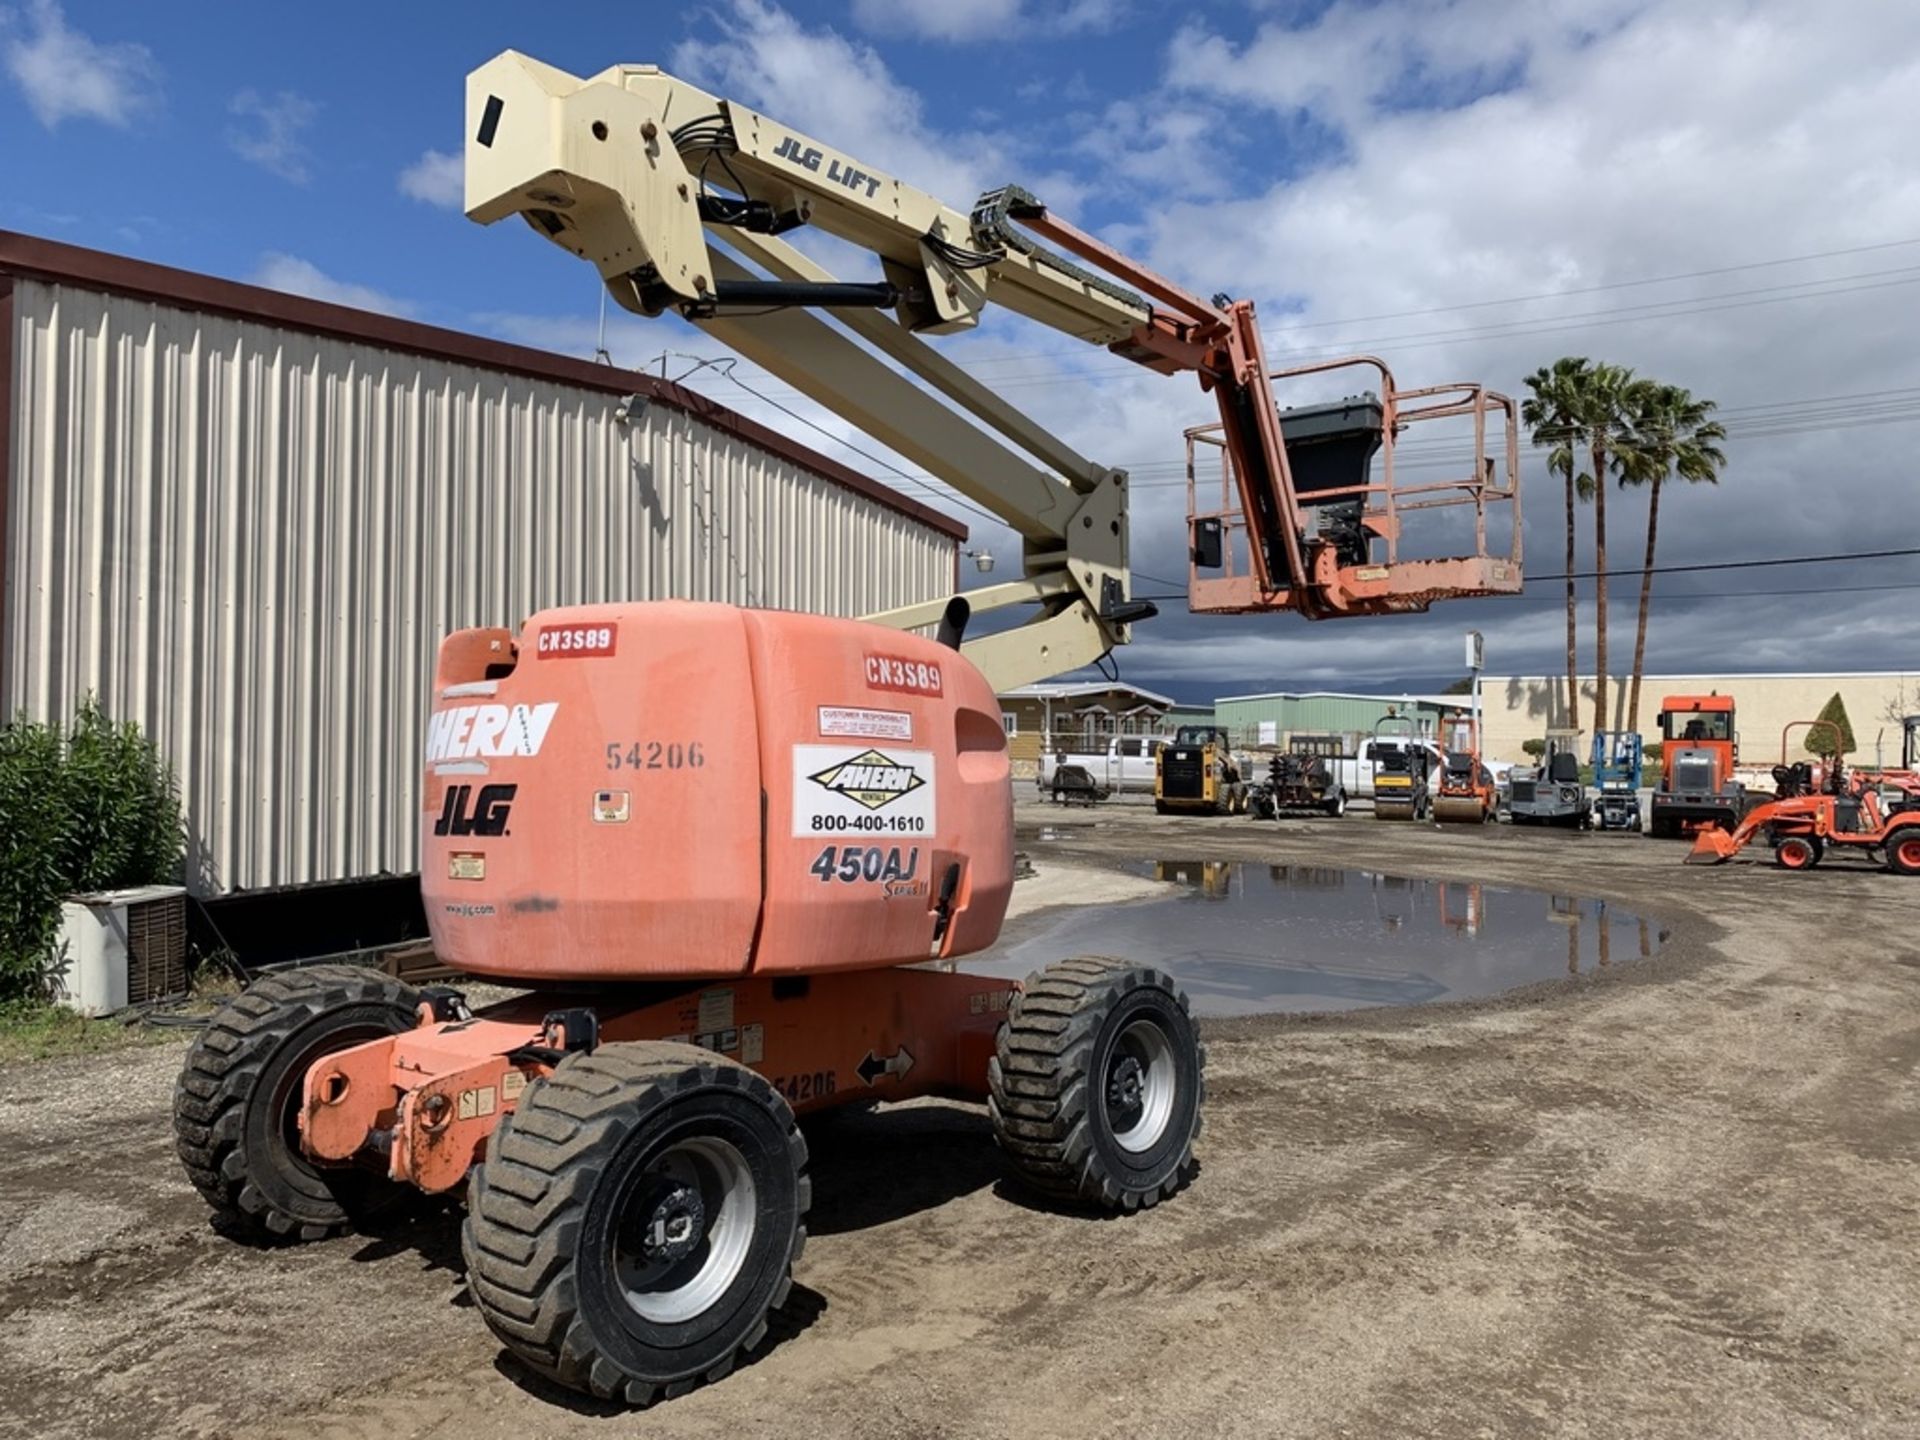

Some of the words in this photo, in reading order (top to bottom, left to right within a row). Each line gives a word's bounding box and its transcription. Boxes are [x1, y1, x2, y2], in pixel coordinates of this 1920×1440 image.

[773, 136, 824, 172] JLG
[826, 159, 881, 198] LIFT
[538, 628, 611, 651] CN3S89
[865, 656, 941, 691] CN3S89
[606, 741, 705, 770] 54206
[828, 764, 913, 790] AHERN
[811, 815, 924, 831] 800-400-1610
[810, 846, 919, 882] 450AJ
